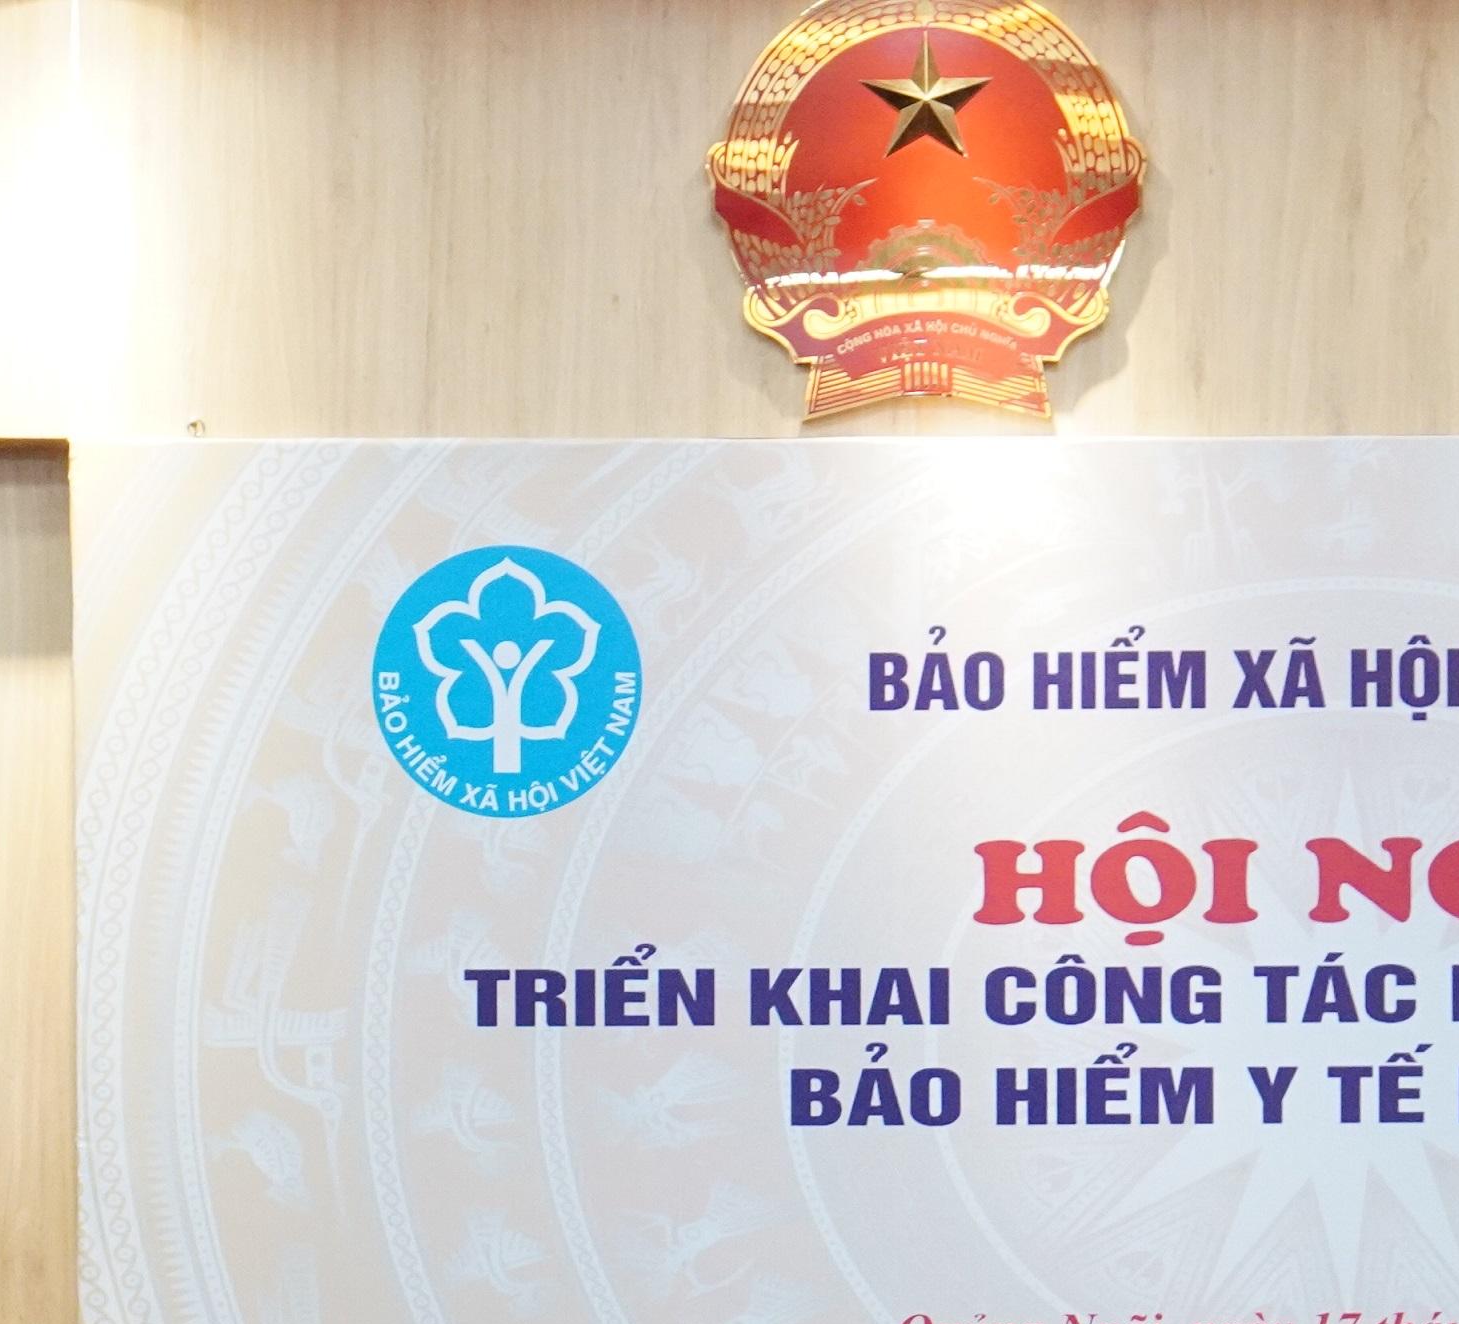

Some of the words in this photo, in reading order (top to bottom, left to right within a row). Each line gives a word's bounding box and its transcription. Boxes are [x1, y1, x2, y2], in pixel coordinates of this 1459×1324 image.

[868, 626, 1005, 711] BẢO
[1032, 626, 1207, 710] HIỂM
[1232, 636, 1326, 710] XÃ
[378, 671, 411, 734] BẢO
[395, 733, 459, 797] HIỂM
[458, 782, 500, 812] XÃ
[507, 779, 559, 812] HỘI
[558, 736, 615, 793] VIỆT
[605, 671, 638, 737] NAM
[972, 811, 1260, 946] HỘI
[463, 942, 715, 1028] TRIỂN
[749, 966, 951, 1026] KHAI
[985, 950, 1222, 1025] CÔNG
[1253, 951, 1418, 1024] TÁC
[789, 1041, 962, 1127] BẢO
[996, 1041, 1215, 1126] HIỂM
[1246, 1066, 1298, 1124] Y
[1326, 1043, 1432, 1124] TẾ
